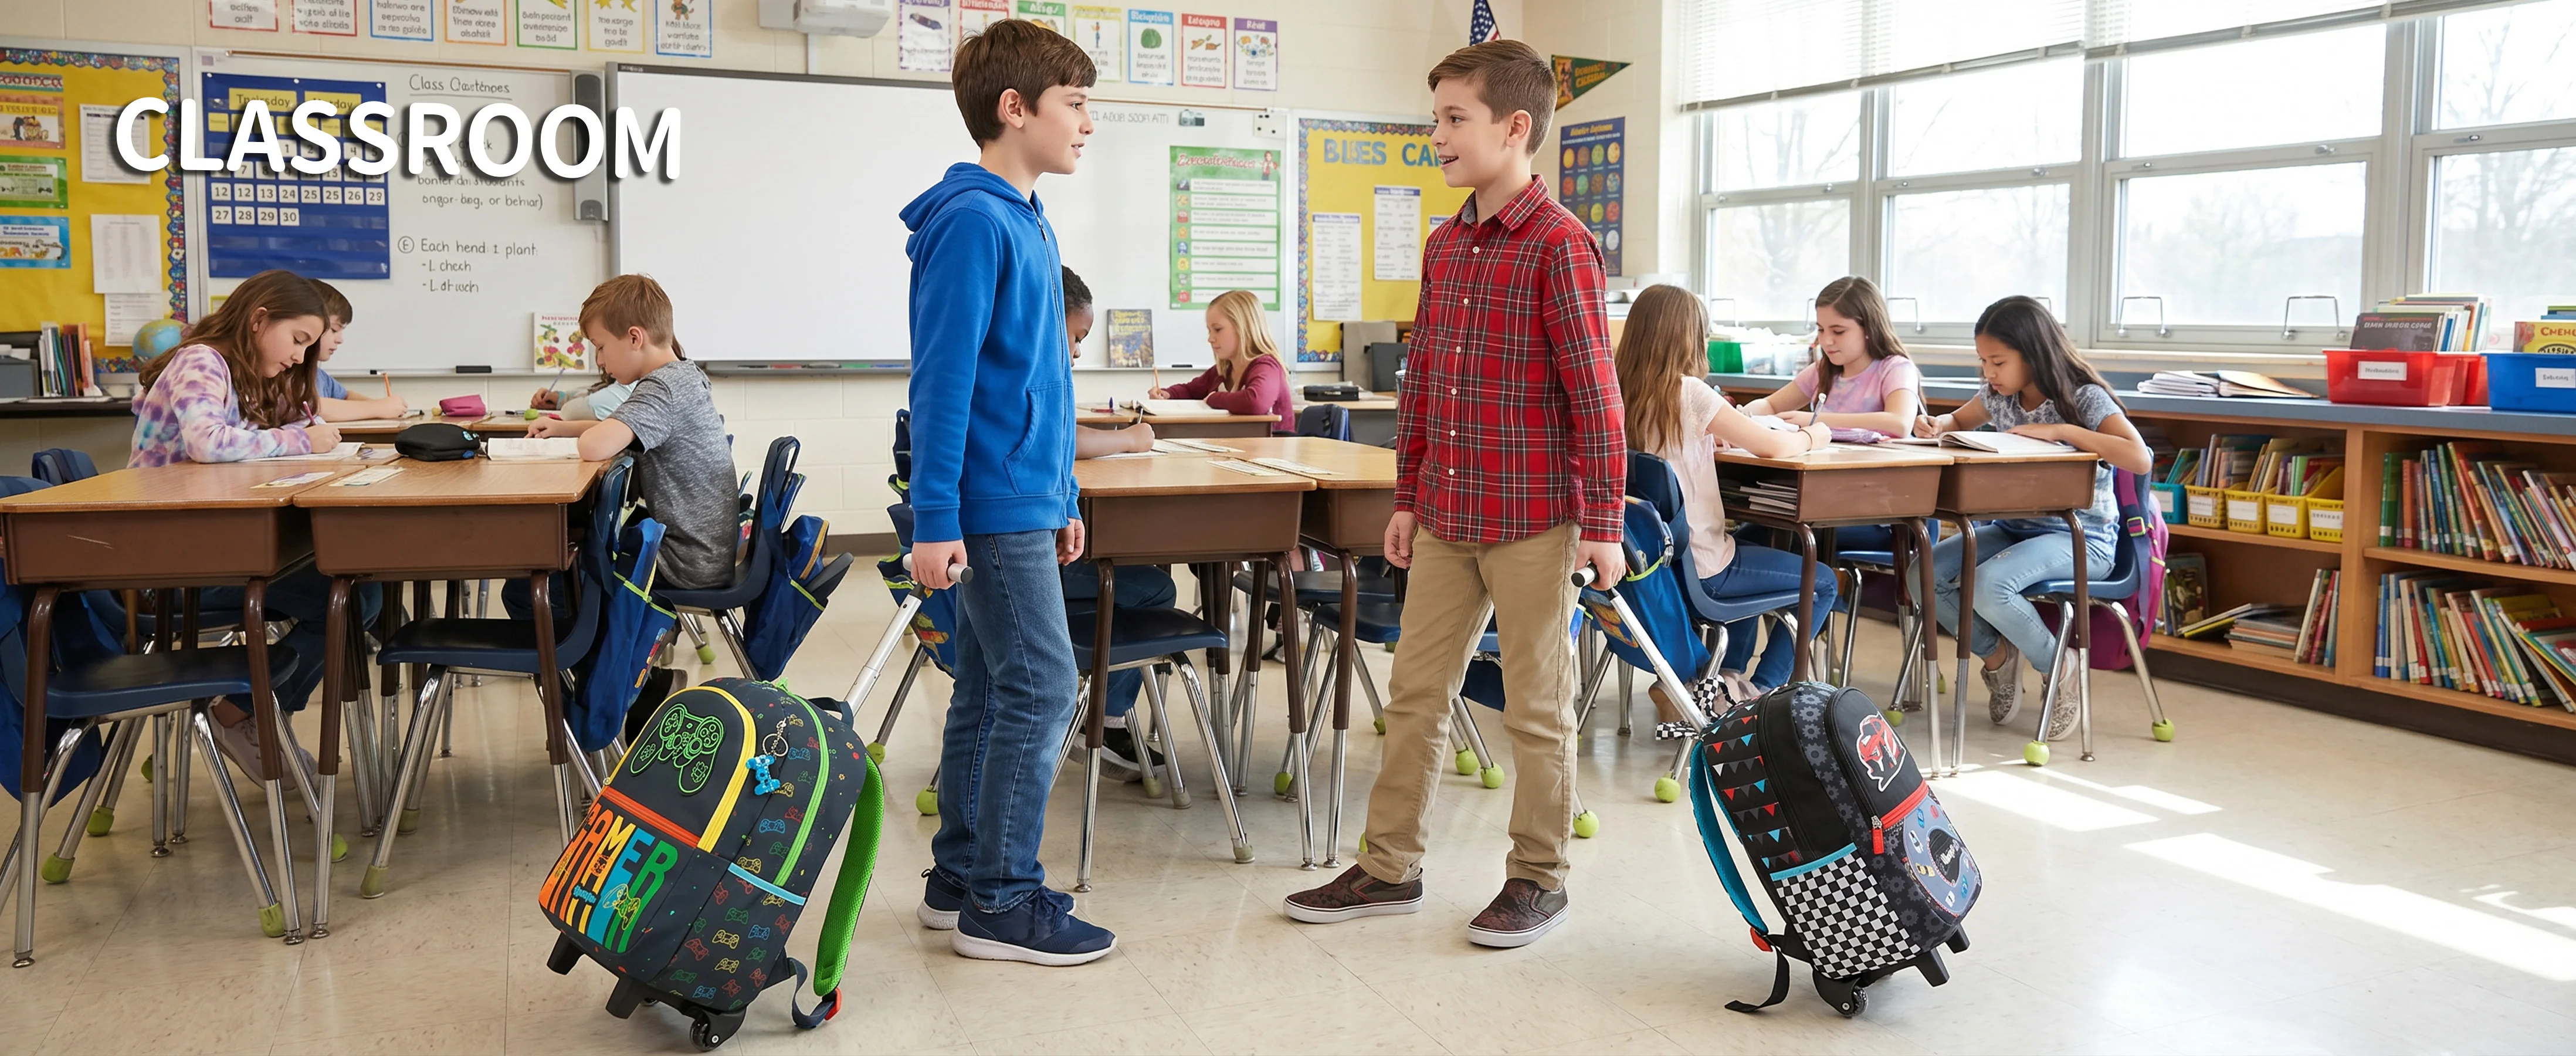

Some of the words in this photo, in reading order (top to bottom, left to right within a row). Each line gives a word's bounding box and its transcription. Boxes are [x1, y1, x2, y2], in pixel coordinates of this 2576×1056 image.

[409, 74, 444, 90] Class
[285, 144, 290, 153] 1
[307, 144, 314, 154] 2
[350, 147, 357, 155] 4
[241, 165, 248, 174] 7
[262, 165, 269, 175] 8
[284, 167, 292, 176] 9
[215, 187, 228, 197] 12
[238, 187, 251, 197] 12
[260, 188, 274, 198] 13
[282, 189, 296, 199] 24
[304, 189, 318, 199] 25
[326, 190, 339, 200] 25
[348, 191, 361, 201] 26
[489, 197, 500, 205] or
[215, 210, 229, 220] 27
[238, 210, 252, 220] 28
[260, 211, 274, 221] 29
[283, 212, 297, 222] 30
[421, 238, 449, 252] Each
